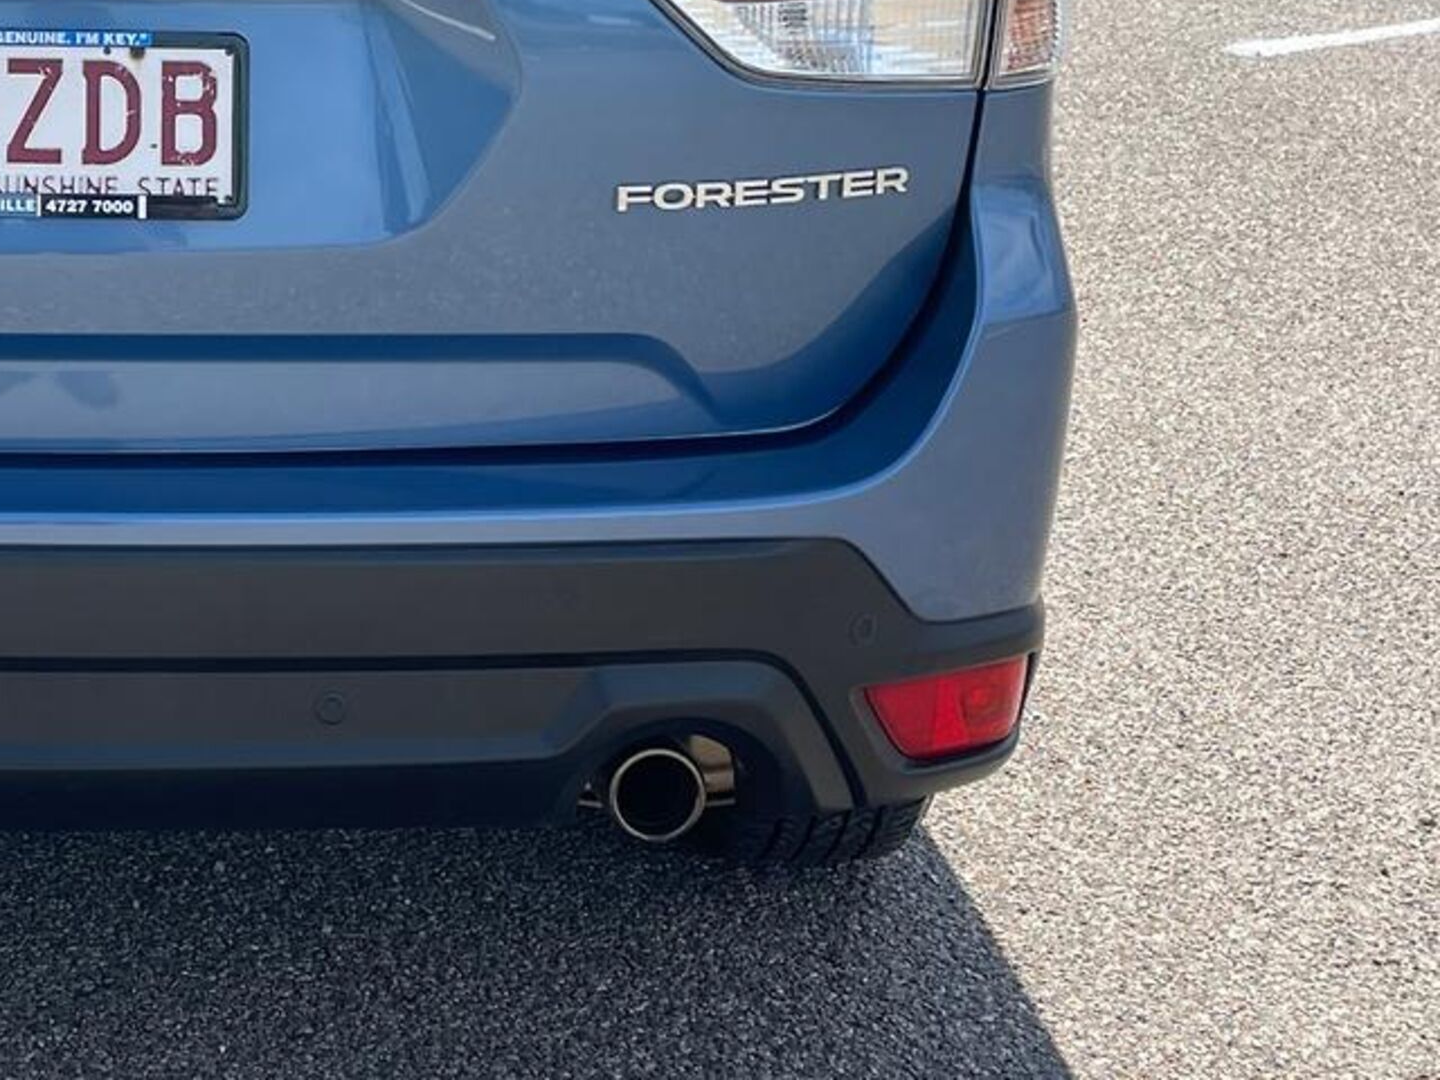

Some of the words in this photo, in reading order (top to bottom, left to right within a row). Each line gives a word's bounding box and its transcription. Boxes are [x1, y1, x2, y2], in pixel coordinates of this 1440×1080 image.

[617, 167, 909, 212] FORESTER
[45, 199, 89, 213] 4727
[93, 199, 134, 213] 7000
